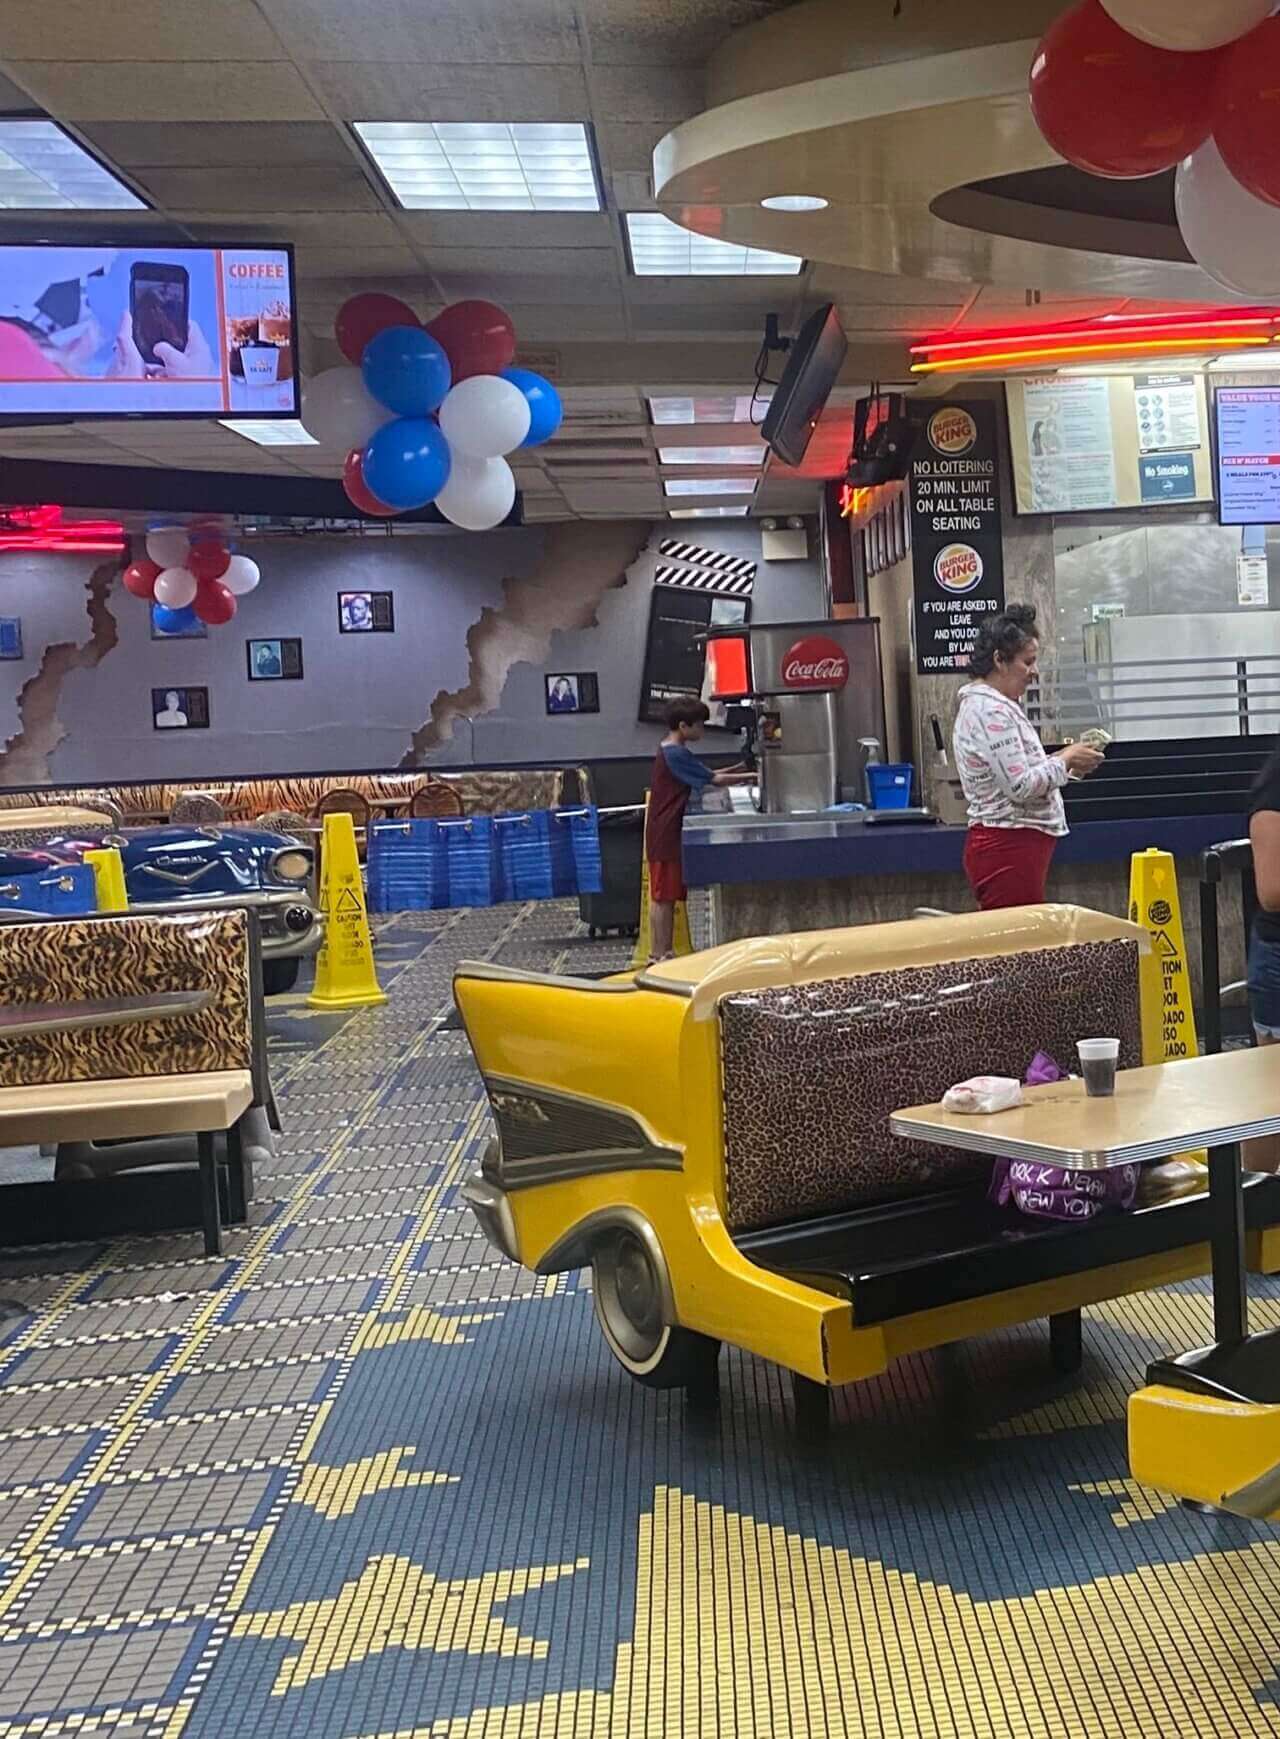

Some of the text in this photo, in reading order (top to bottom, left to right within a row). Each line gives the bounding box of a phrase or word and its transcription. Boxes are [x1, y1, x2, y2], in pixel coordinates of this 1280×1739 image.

[228, 264, 284, 278] COFFEE
[935, 424, 972, 448] KING
[913, 460, 994, 474] NO LOITERING
[1144, 463, 1189, 478] No Smoking
[918, 480, 991, 494] 20 MIN. LIMIT
[916, 498, 994, 512] ON ALL TABLE
[932, 516, 981, 530] SEATING
[940, 552, 975, 570] BURGER
[942, 561, 977, 582] KING
[923, 600, 997, 612] IF YOU ARE ASKED TO
[950, 614, 972, 625] LEAVE
[934, 630, 949, 640] AND
[951, 629, 966, 639] YOU
[948, 642, 958, 652] BY
[923, 657, 938, 667] YOU
[940, 656, 953, 666] ARE
[785, 658, 845, 681] Coca-Cola
[1162, 960, 1182, 975] TION
[1164, 977, 1173, 990] ET
[1165, 1042, 1187, 1057] JADO
